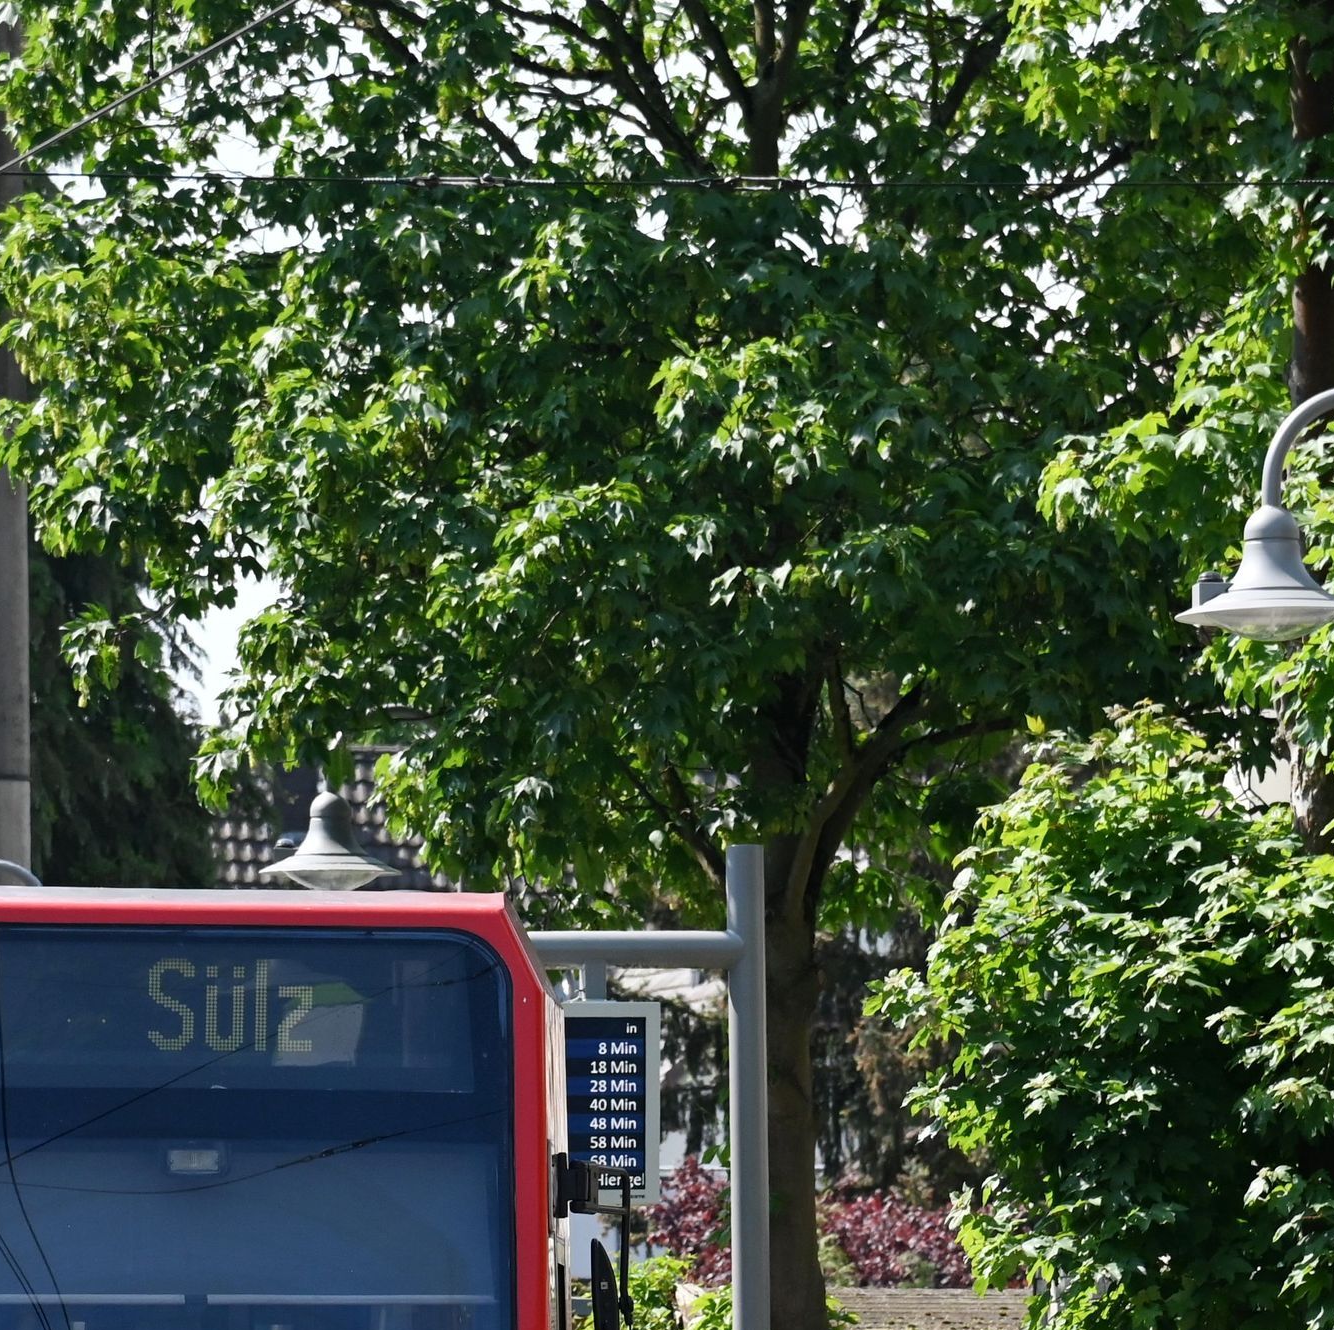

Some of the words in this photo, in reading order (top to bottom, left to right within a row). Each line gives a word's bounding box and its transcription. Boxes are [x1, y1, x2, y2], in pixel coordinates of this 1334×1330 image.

[147, 957, 314, 1053] Sülz
[626, 1022, 637, 1034] in
[598, 1042, 607, 1055] 8
[611, 1042, 637, 1055] Min
[590, 1061, 607, 1074] 18
[611, 1061, 637, 1074] Min
[589, 1080, 607, 1093] 28
[611, 1080, 637, 1093] Min
[589, 1098, 607, 1111] 40
[611, 1098, 637, 1111] Min
[589, 1117, 607, 1130] 48
[611, 1117, 637, 1130] Min
[589, 1136, 607, 1149] 58
[611, 1136, 637, 1149] Min
[611, 1155, 637, 1168] Min
